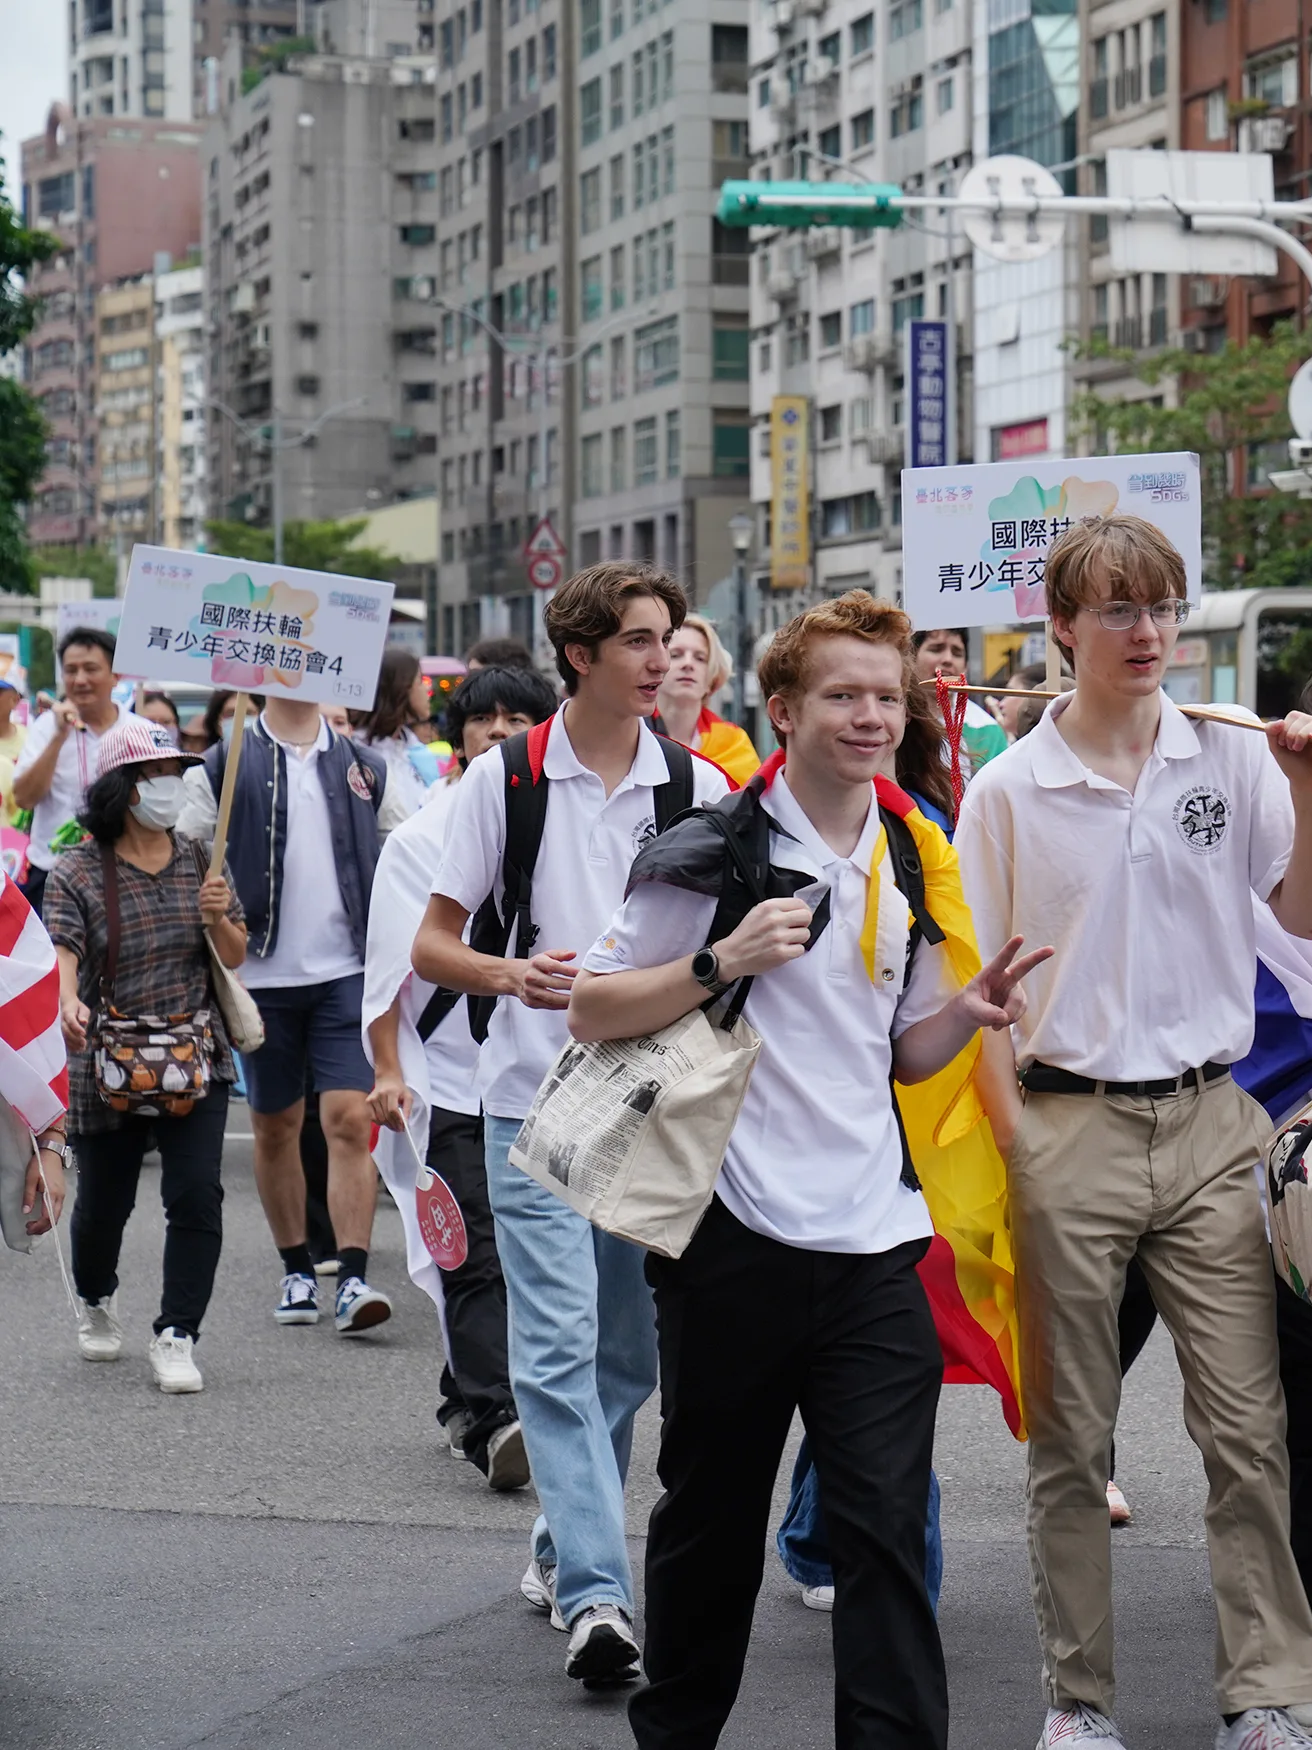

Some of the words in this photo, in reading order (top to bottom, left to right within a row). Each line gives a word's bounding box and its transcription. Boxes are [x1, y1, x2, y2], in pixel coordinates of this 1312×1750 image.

[917, 329, 943, 464] 古亭動物醫院
[1150, 488, 1189, 503] SDGs
[200, 602, 303, 639] 國際扶輪
[148, 626, 343, 676] 青少年交換協會4
[335, 681, 363, 697] 1-13
